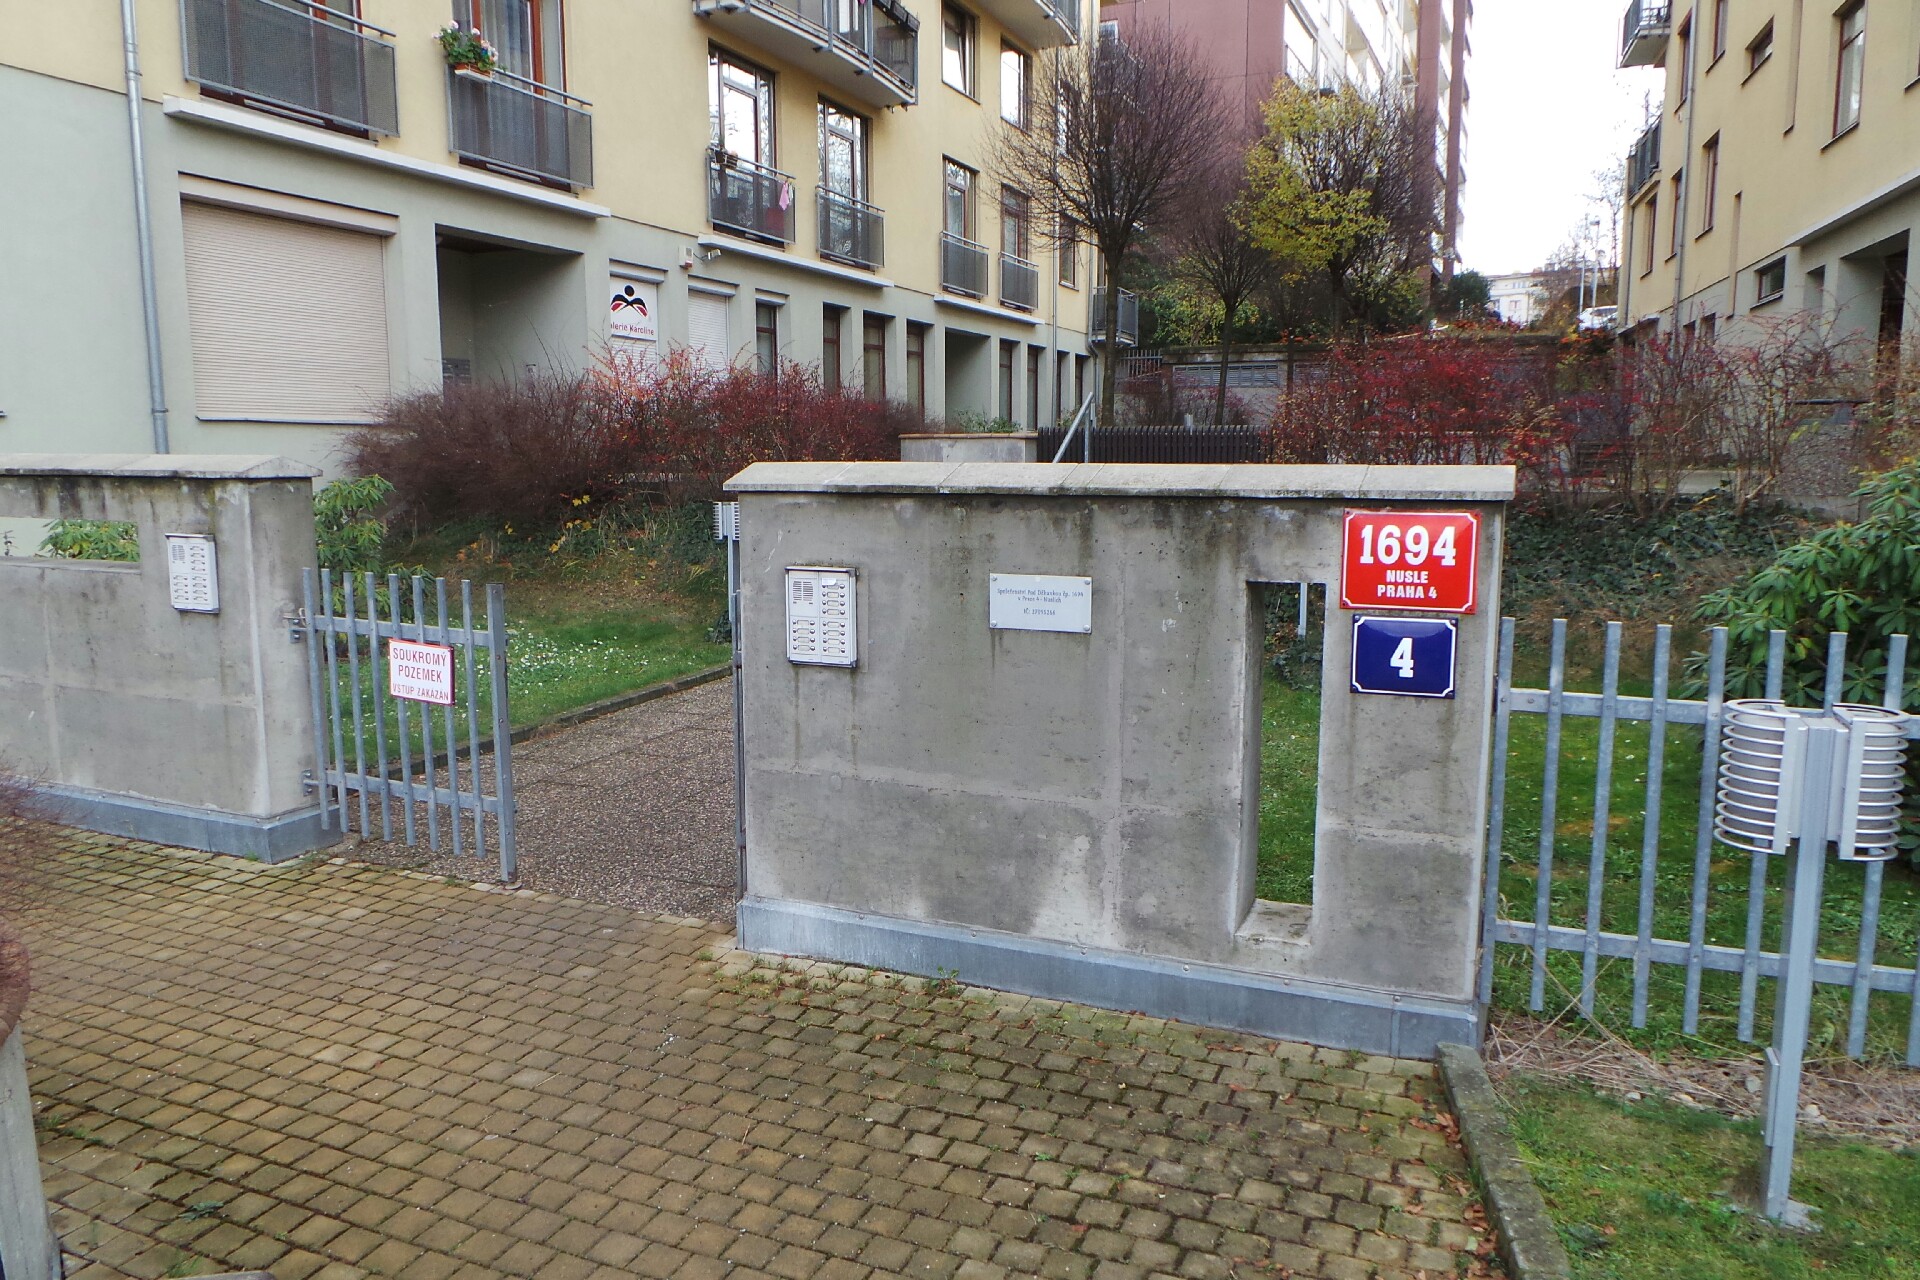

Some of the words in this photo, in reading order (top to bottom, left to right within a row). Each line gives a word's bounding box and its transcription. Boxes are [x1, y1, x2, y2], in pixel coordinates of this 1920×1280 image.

[1359, 524, 1457, 566] 1694
[1386, 570, 1429, 584] NUSLE
[1377, 585, 1425, 599] PRAHA
[1428, 587, 1438, 599] 4
[393, 648, 446, 666] SOUKROMÝ
[1390, 637, 1414, 678] 4
[398, 664, 442, 683] POZEMEK
[392, 683, 415, 695] VSTUP
